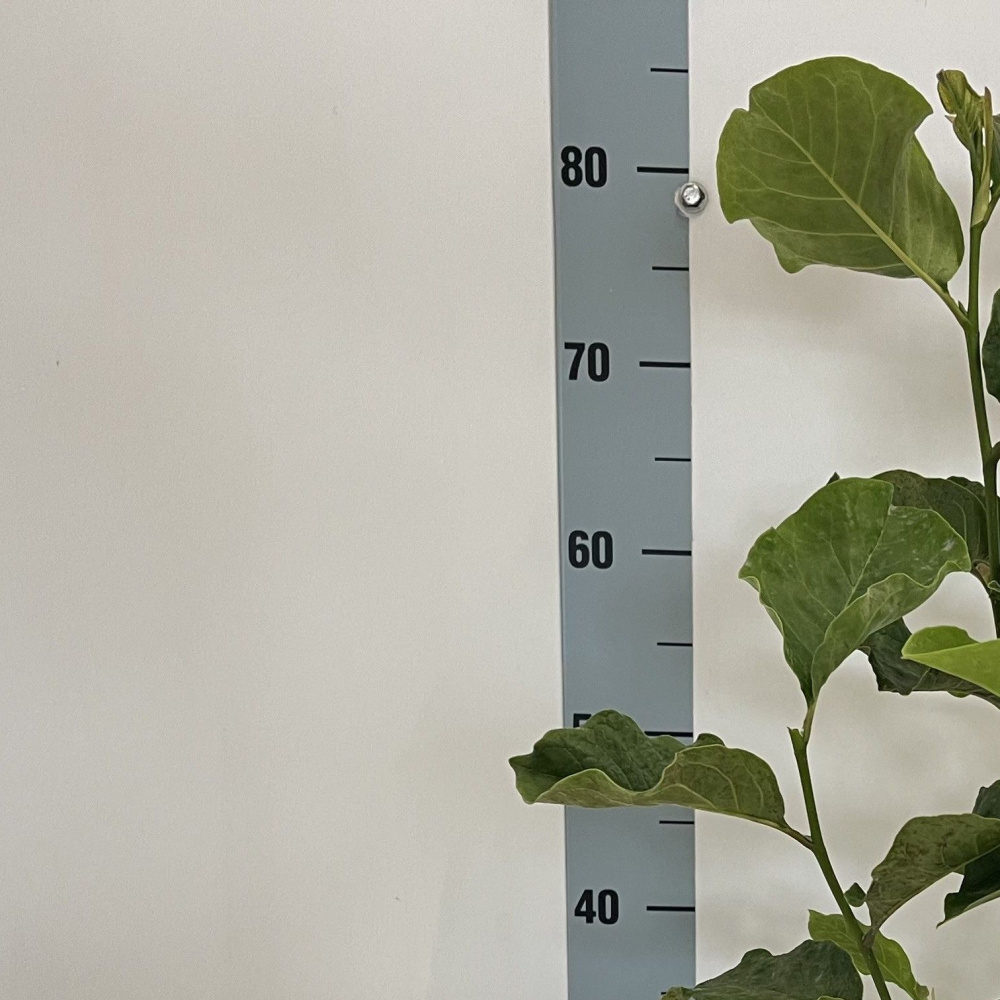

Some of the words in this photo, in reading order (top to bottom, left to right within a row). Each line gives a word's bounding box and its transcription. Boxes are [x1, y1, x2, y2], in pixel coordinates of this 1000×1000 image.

[560, 145, 608, 188] 80
[564, 341, 610, 382] 70
[567, 529, 614, 570] 60
[574, 888, 619, 925] 40
